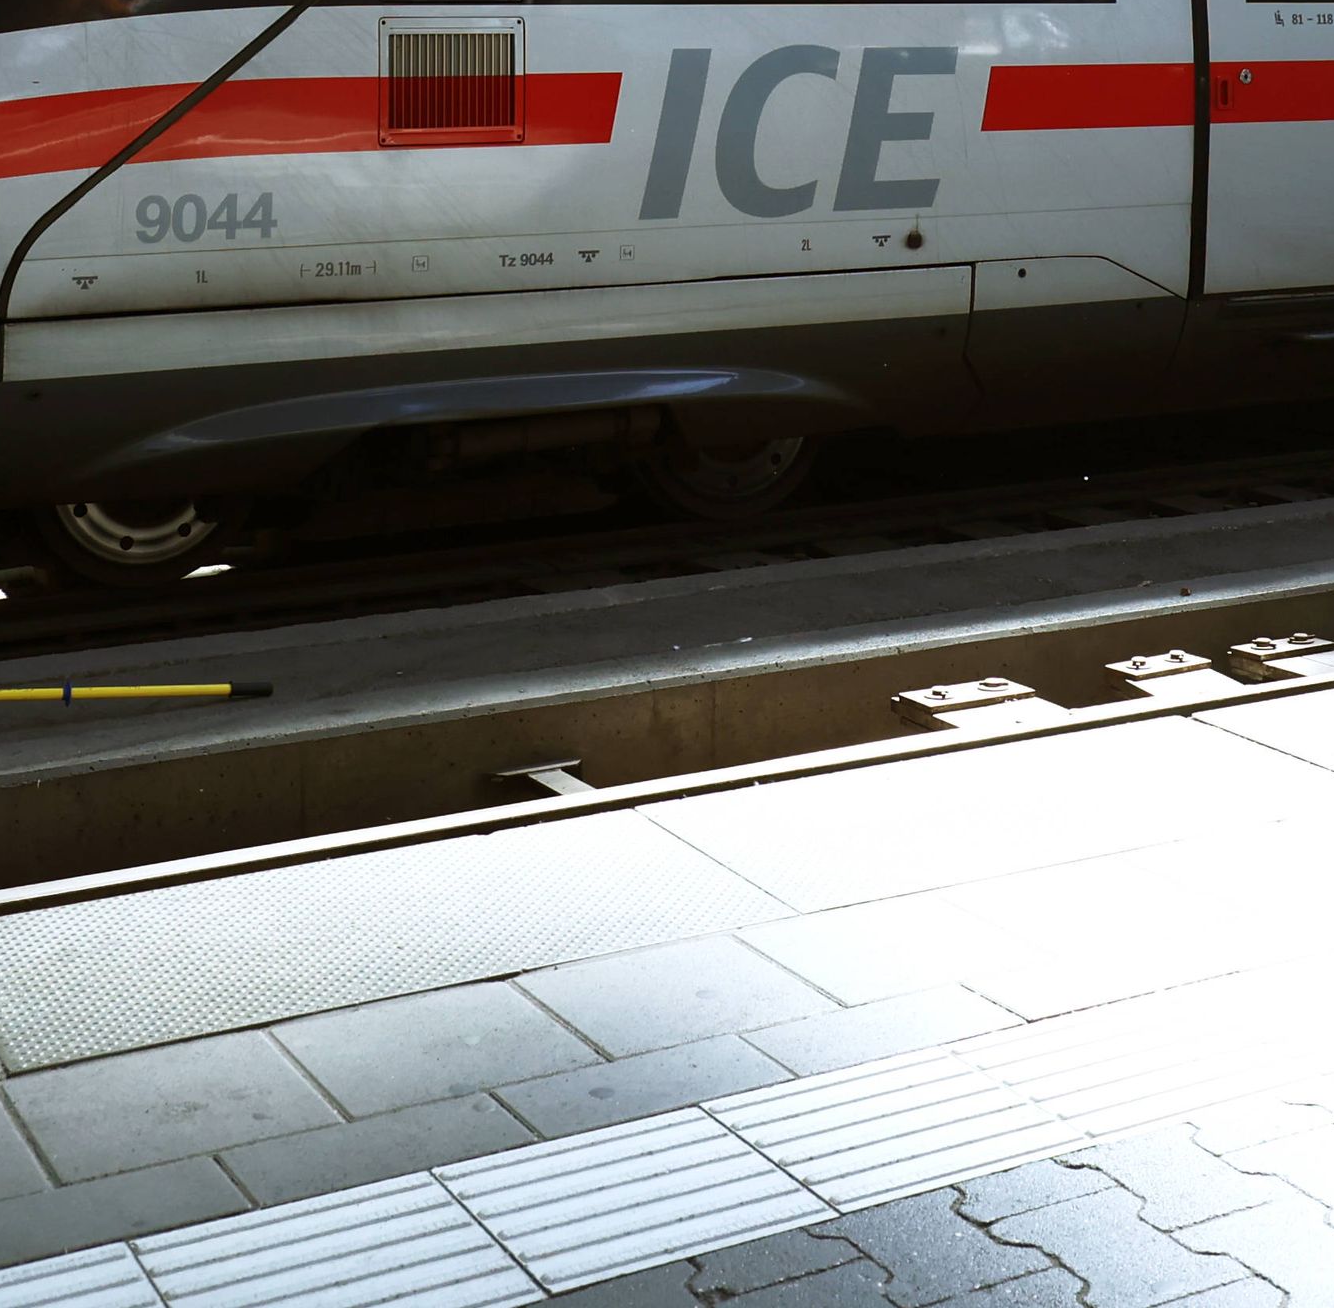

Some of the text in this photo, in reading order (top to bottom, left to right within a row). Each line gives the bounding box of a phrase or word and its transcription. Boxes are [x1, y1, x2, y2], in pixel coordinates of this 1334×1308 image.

[1292, 13, 1304, 25] 81
[1316, 13, 1334, 25] 118
[638, 44, 959, 221] ICE
[135, 192, 278, 244] 9044
[801, 239, 812, 251] 2L
[499, 252, 555, 268] Tz 9044
[195, 270, 209, 284] 1L
[315, 260, 362, 278] 29.11m
